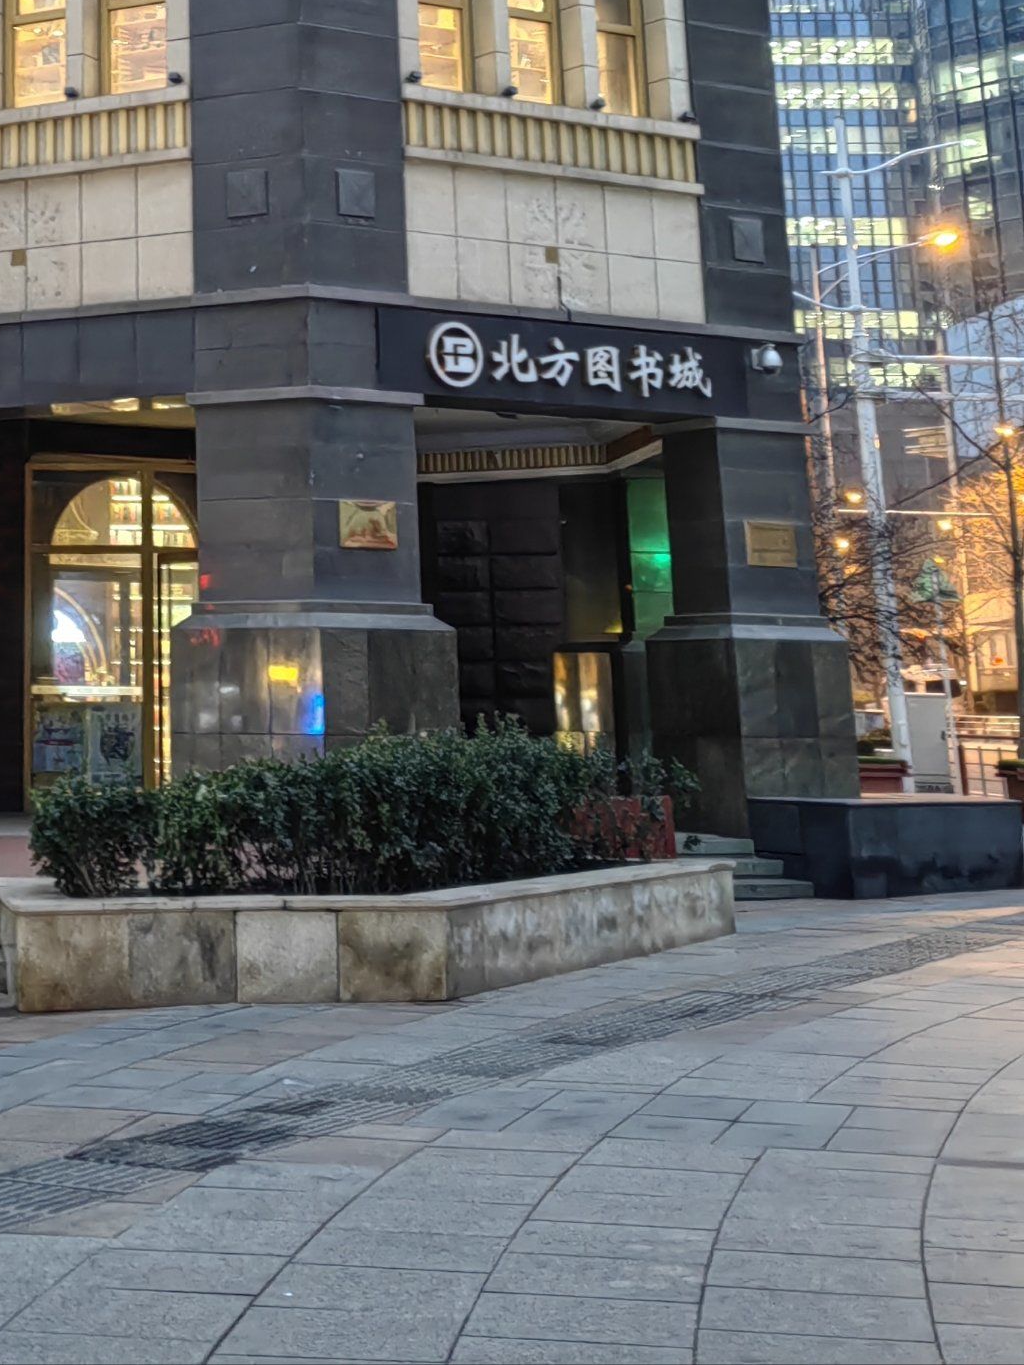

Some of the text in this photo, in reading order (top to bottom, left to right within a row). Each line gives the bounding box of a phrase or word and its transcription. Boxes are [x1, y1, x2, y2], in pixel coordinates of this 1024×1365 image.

[491, 335, 712, 397] 北方图书城
